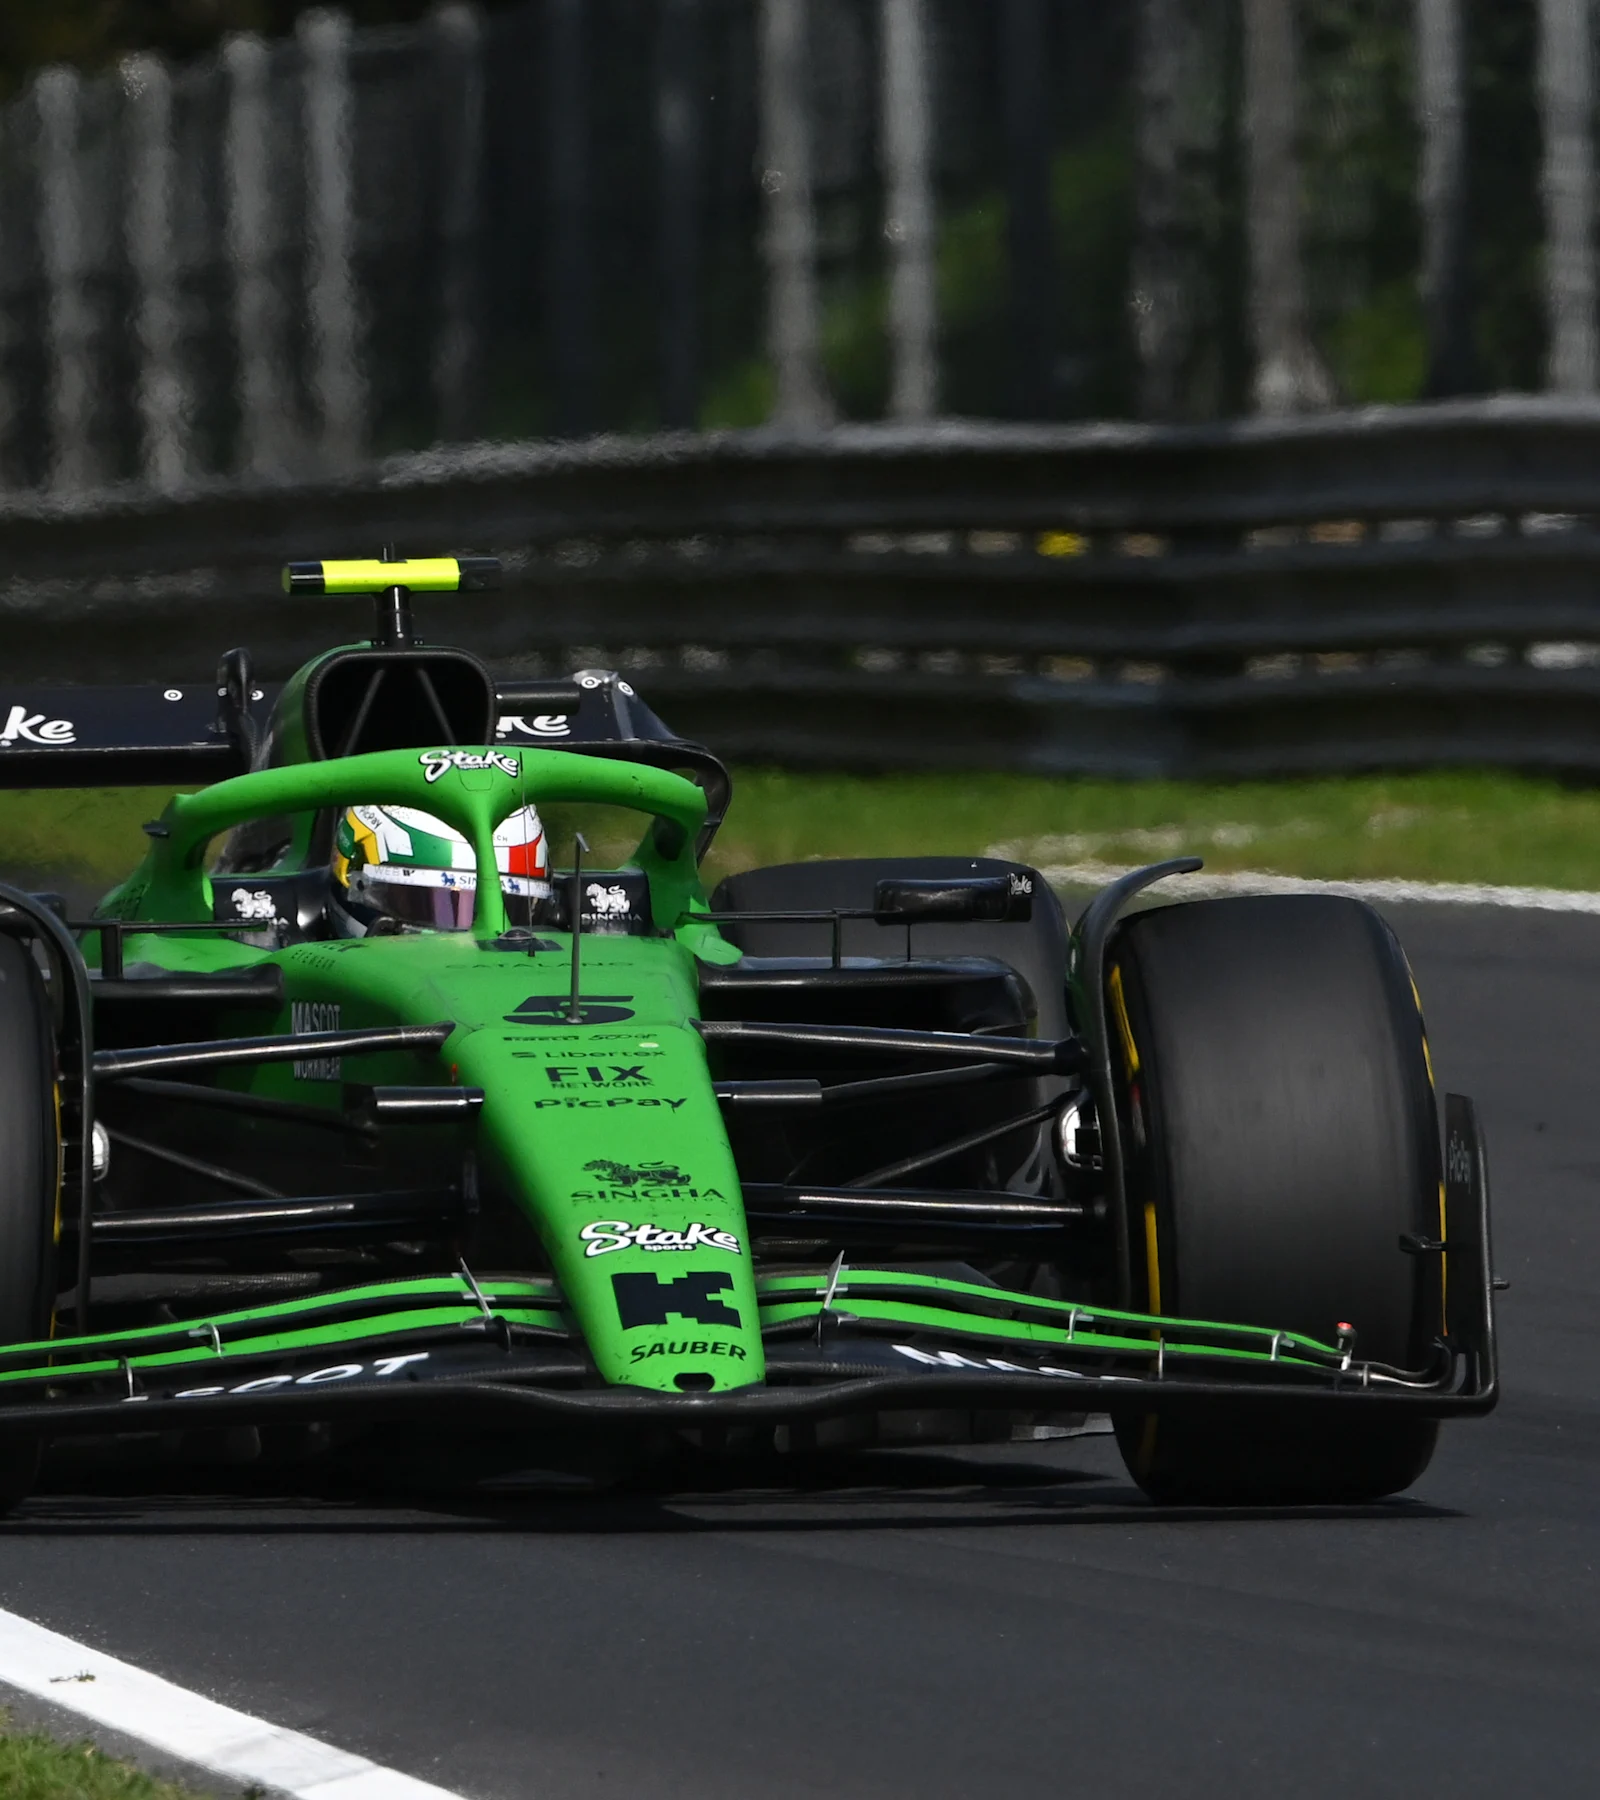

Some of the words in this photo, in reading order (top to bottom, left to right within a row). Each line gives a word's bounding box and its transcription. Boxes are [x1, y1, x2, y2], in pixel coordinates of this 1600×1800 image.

[419, 750, 519, 783] Stake
[502, 995, 635, 1026] 5
[545, 1065, 652, 1082] FIX
[551, 1081, 655, 1089] NETWORK
[534, 1097, 688, 1113] PicPay
[570, 1188, 727, 1201] SINGHA
[580, 1220, 741, 1257] Stake
[643, 1243, 695, 1252] sports
[629, 1341, 747, 1364] SAUBER
